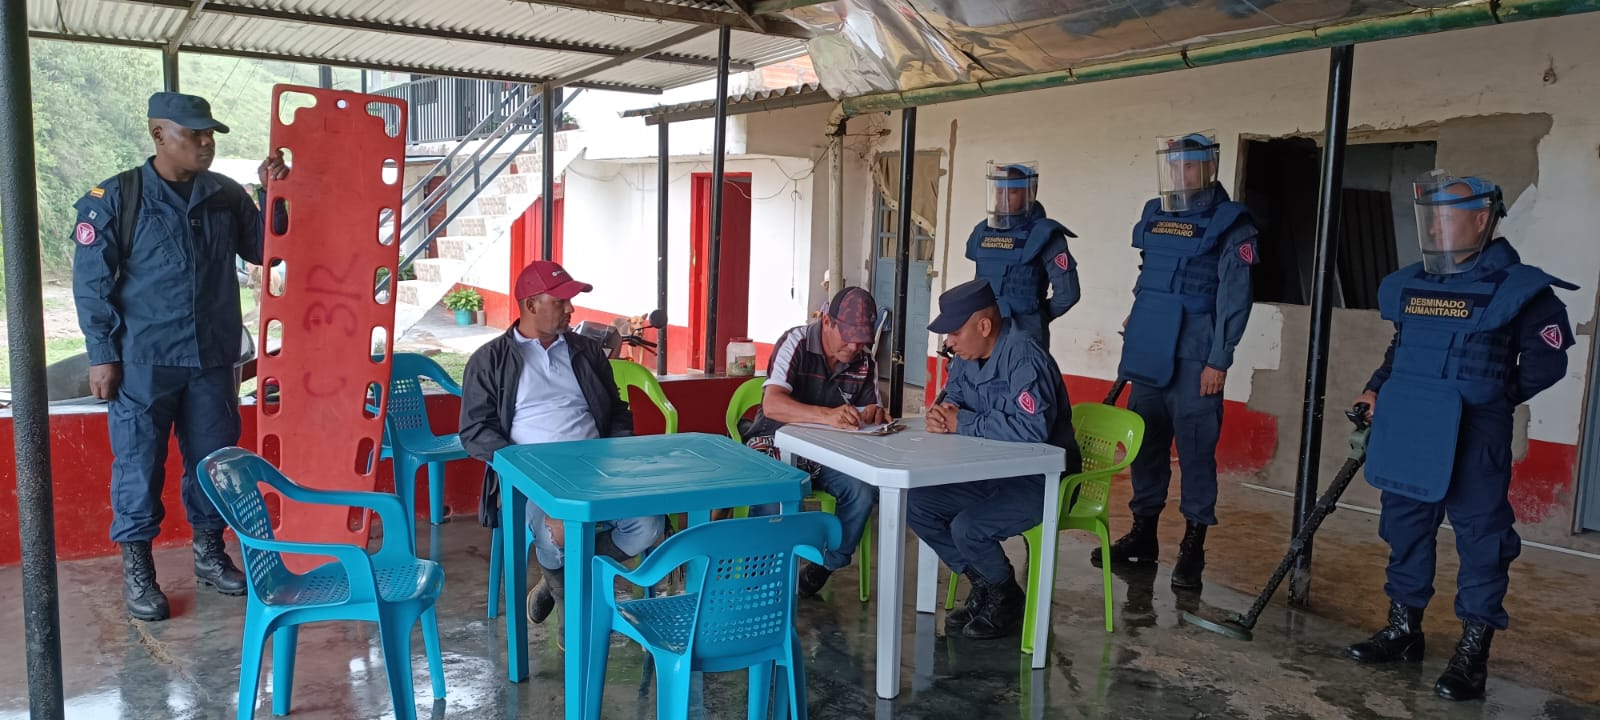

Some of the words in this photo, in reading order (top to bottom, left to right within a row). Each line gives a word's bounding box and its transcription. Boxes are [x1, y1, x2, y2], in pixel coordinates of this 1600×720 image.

[1151, 227, 1193, 237] HUMANITARIO
[1410, 297, 1466, 309] DESMINADO
[1404, 305, 1469, 318] HUMANITARIO
